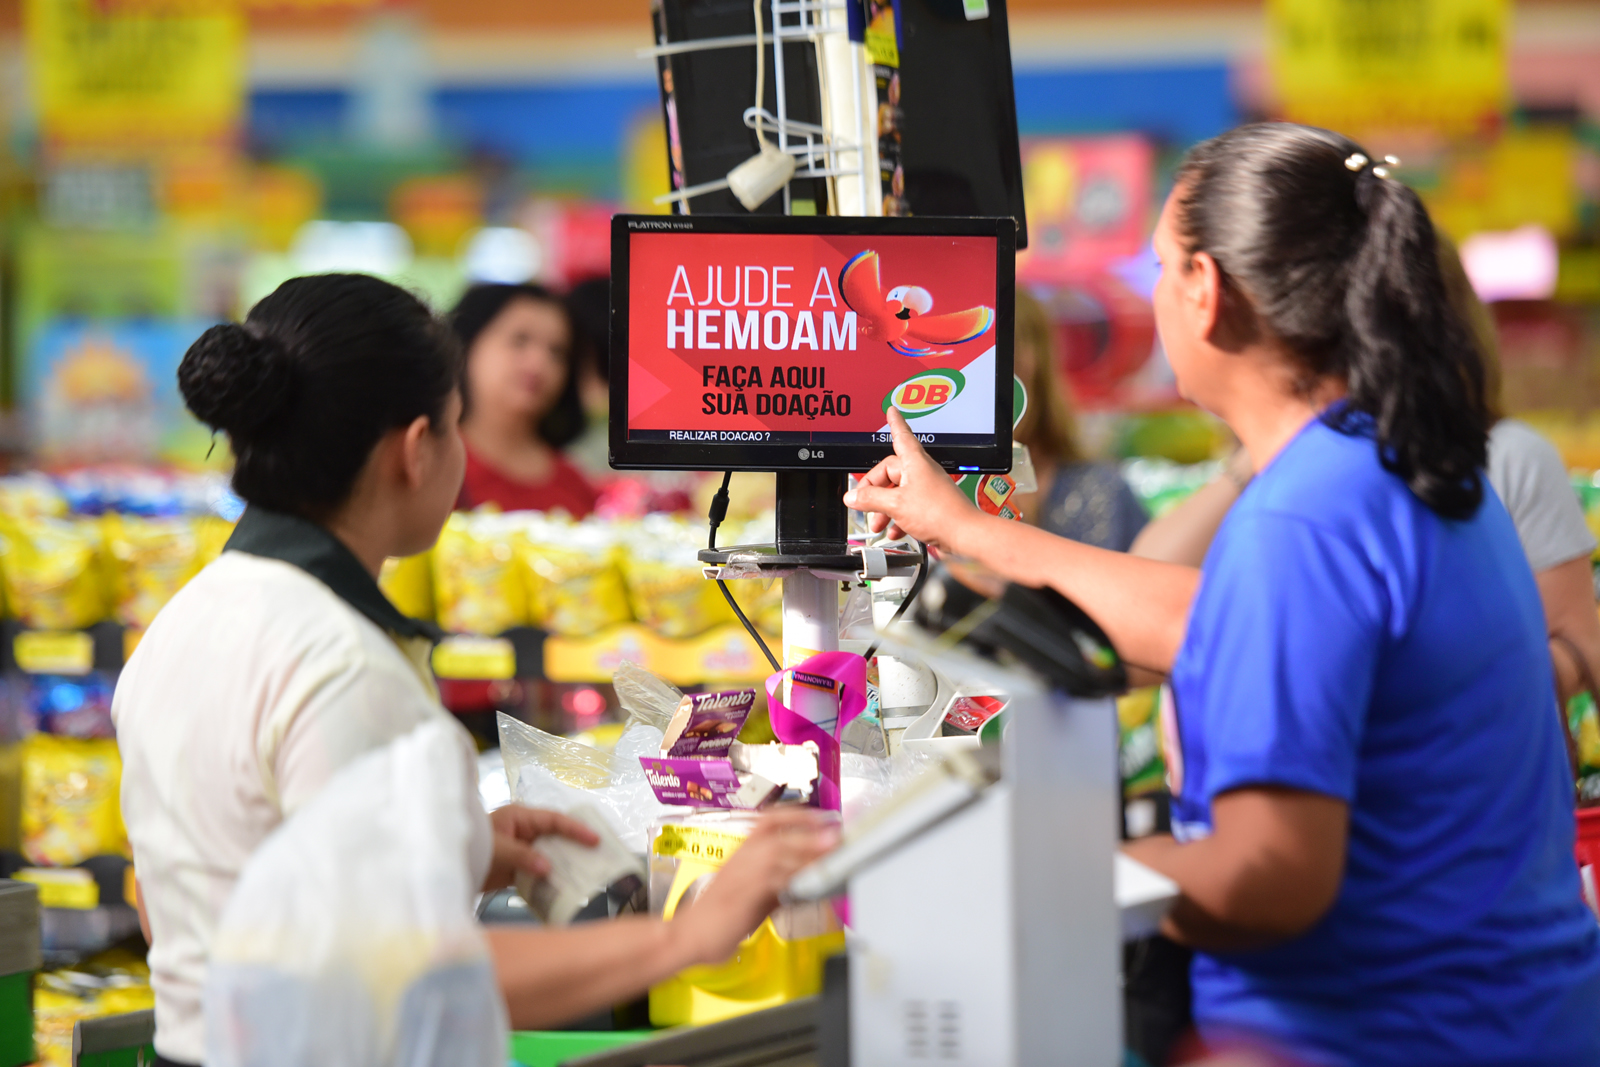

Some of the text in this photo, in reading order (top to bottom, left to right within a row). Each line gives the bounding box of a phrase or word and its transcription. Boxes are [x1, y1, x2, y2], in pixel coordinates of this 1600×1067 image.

[628, 221, 672, 229] FLATRON
[666, 265, 837, 307] AJUDE A
[667, 309, 857, 351] HEMOAM
[703, 365, 825, 392] FAÇA AQUI
[702, 390, 851, 420] SUA DOAÇÃO
[901, 384, 949, 405] DB
[669, 431, 771, 441] REALIZAR DOACAO ?
[811, 450, 825, 459] LG
[794, 672, 833, 688] TRAMONTINA
[696, 691, 752, 712] Talento
[645, 768, 680, 788] Talento
